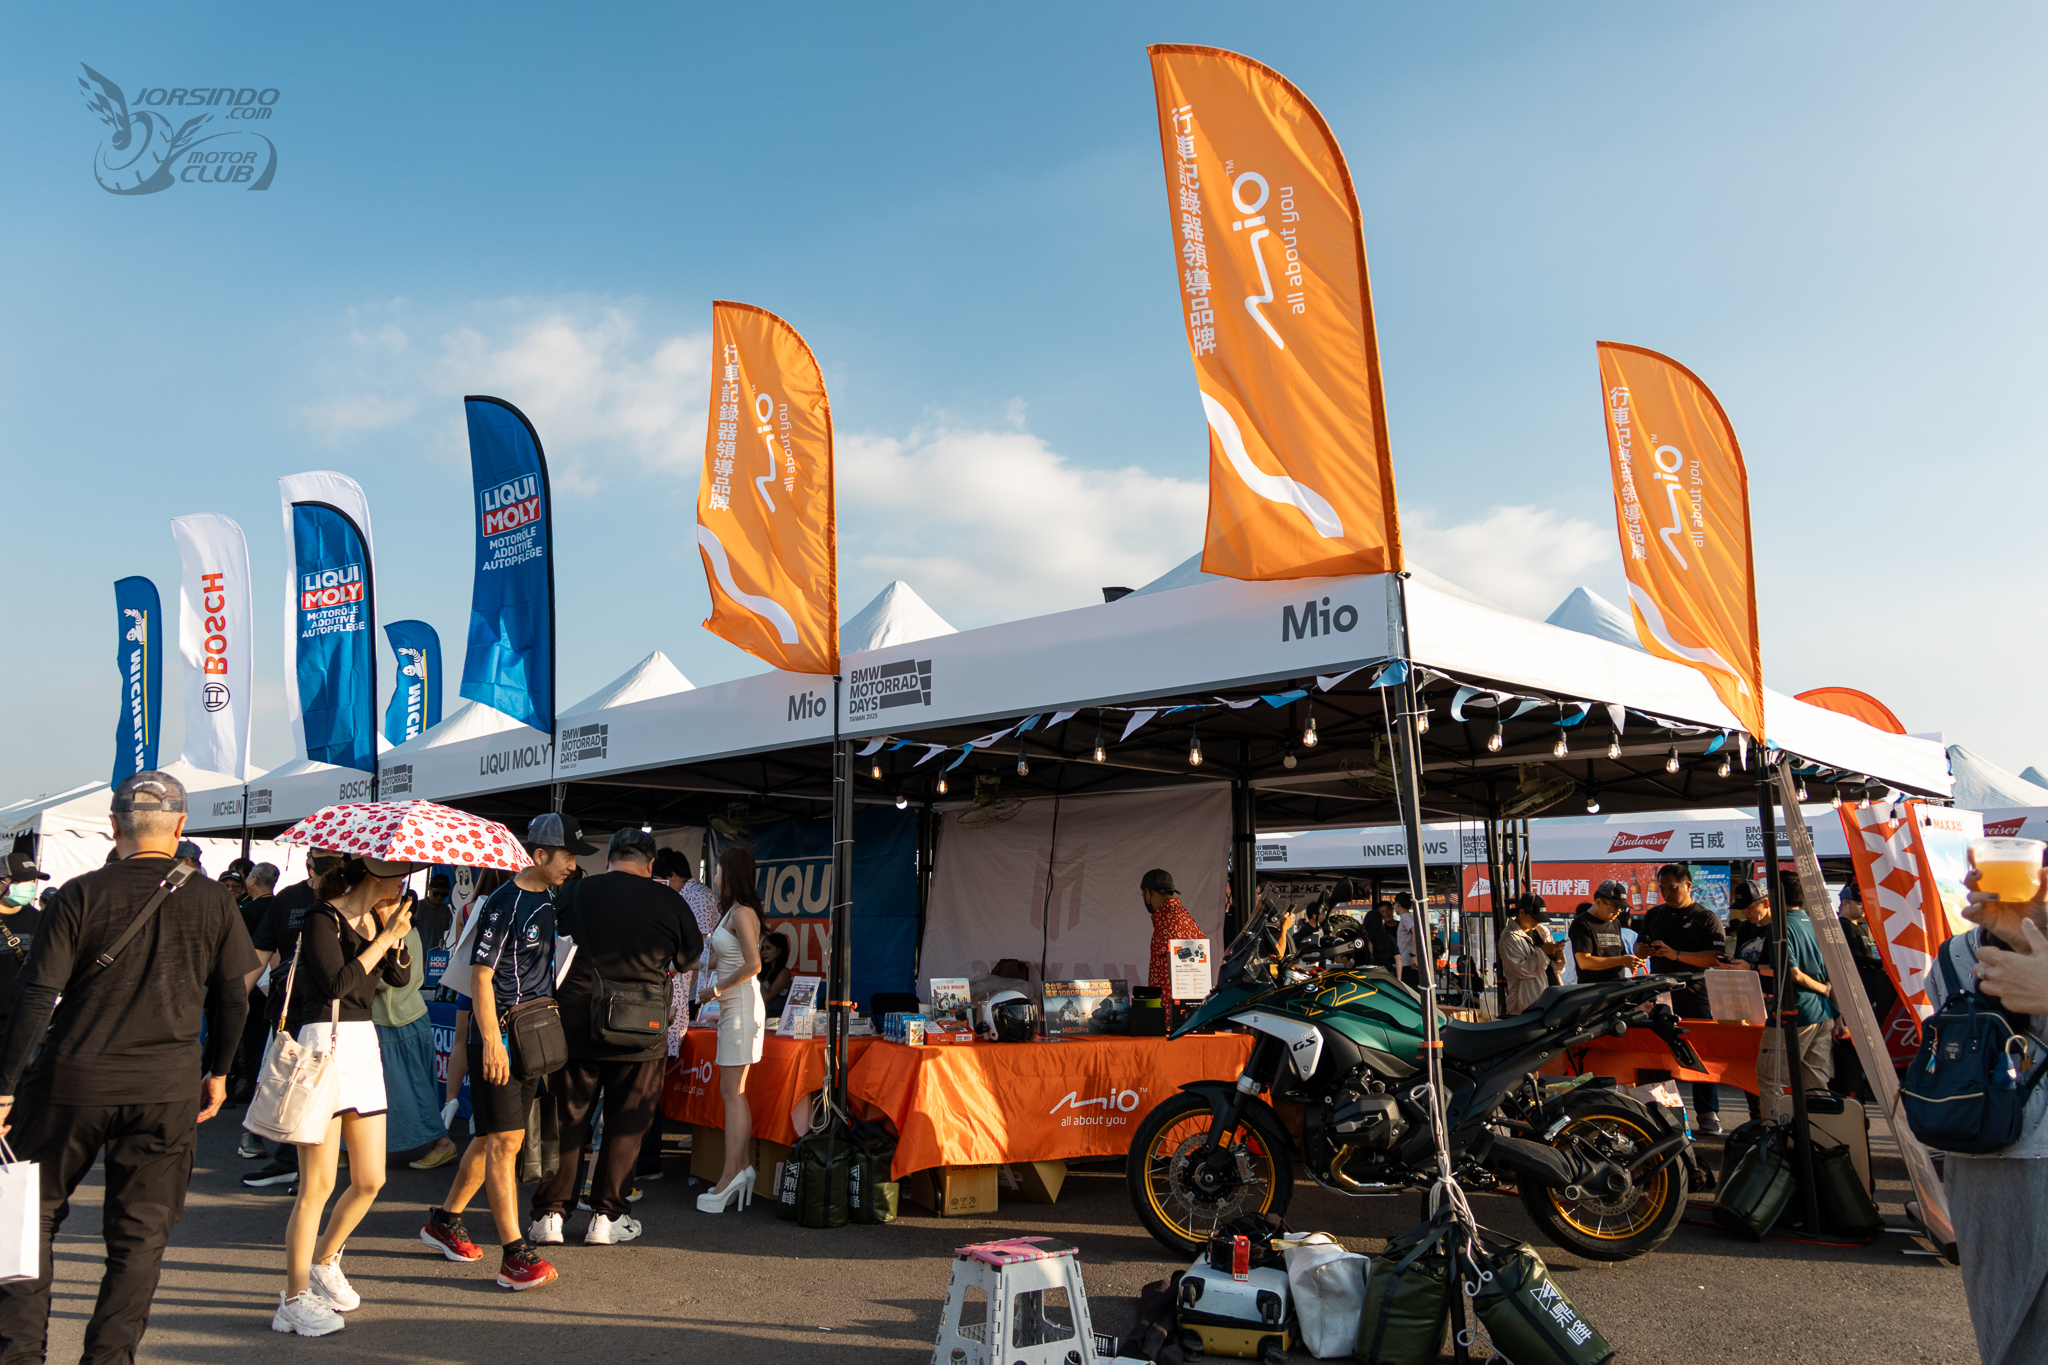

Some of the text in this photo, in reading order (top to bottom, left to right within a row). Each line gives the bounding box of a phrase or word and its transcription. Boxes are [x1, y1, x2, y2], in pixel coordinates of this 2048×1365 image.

[1171, 104, 1217, 357] 行車記錄器領導品牌
[1280, 186, 1305, 315] all about you
[708, 343, 740, 512] 行車記錄器領導品牌
[779, 403, 796, 492] all about you
[484, 476, 537, 512] LIQUI
[1688, 459, 1704, 548] all about you
[485, 497, 539, 534] MOLY
[489, 526, 537, 550] MOTORÖLE
[482, 546, 543, 571] AUTOPFLEGE
[493, 538, 533, 560] ADDITIVE
[305, 565, 359, 591] LIQUI
[305, 583, 362, 608] MOLY
[306, 605, 359, 621] MOTORÖLE
[310, 614, 356, 629] ADDITIVE
[1281, 596, 1359, 643] Mio
[301, 621, 365, 638] AUTOPFLEGE
[851, 665, 881, 685] BMW
[850, 674, 919, 700] MOTORRAD
[787, 690, 827, 722] Mio
[849, 696, 878, 714] DAYS
[849, 714, 866, 722] TAIWAN
[561, 735, 601, 752] MOTORRAD
[562, 727, 580, 741] BMW
[480, 743, 550, 776] LIQUI MOLY
[560, 750, 578, 764] DAYS
[382, 766, 394, 778] BMW
[382, 773, 408, 787] MOTORRAD
[339, 779, 371, 801] BOSCH
[381, 785, 393, 797] DAYS
[212, 799, 242, 817] MICHELIN
[1745, 826, 1762, 834] BM
[1933, 817, 1963, 832] MAXXIS
[1611, 831, 1725, 850] Budweiser 百威
[1531, 879, 1589, 896] 百威啤酒
[1292, 1035, 1317, 1051] GS
[1061, 1115, 1127, 1128] all about you
